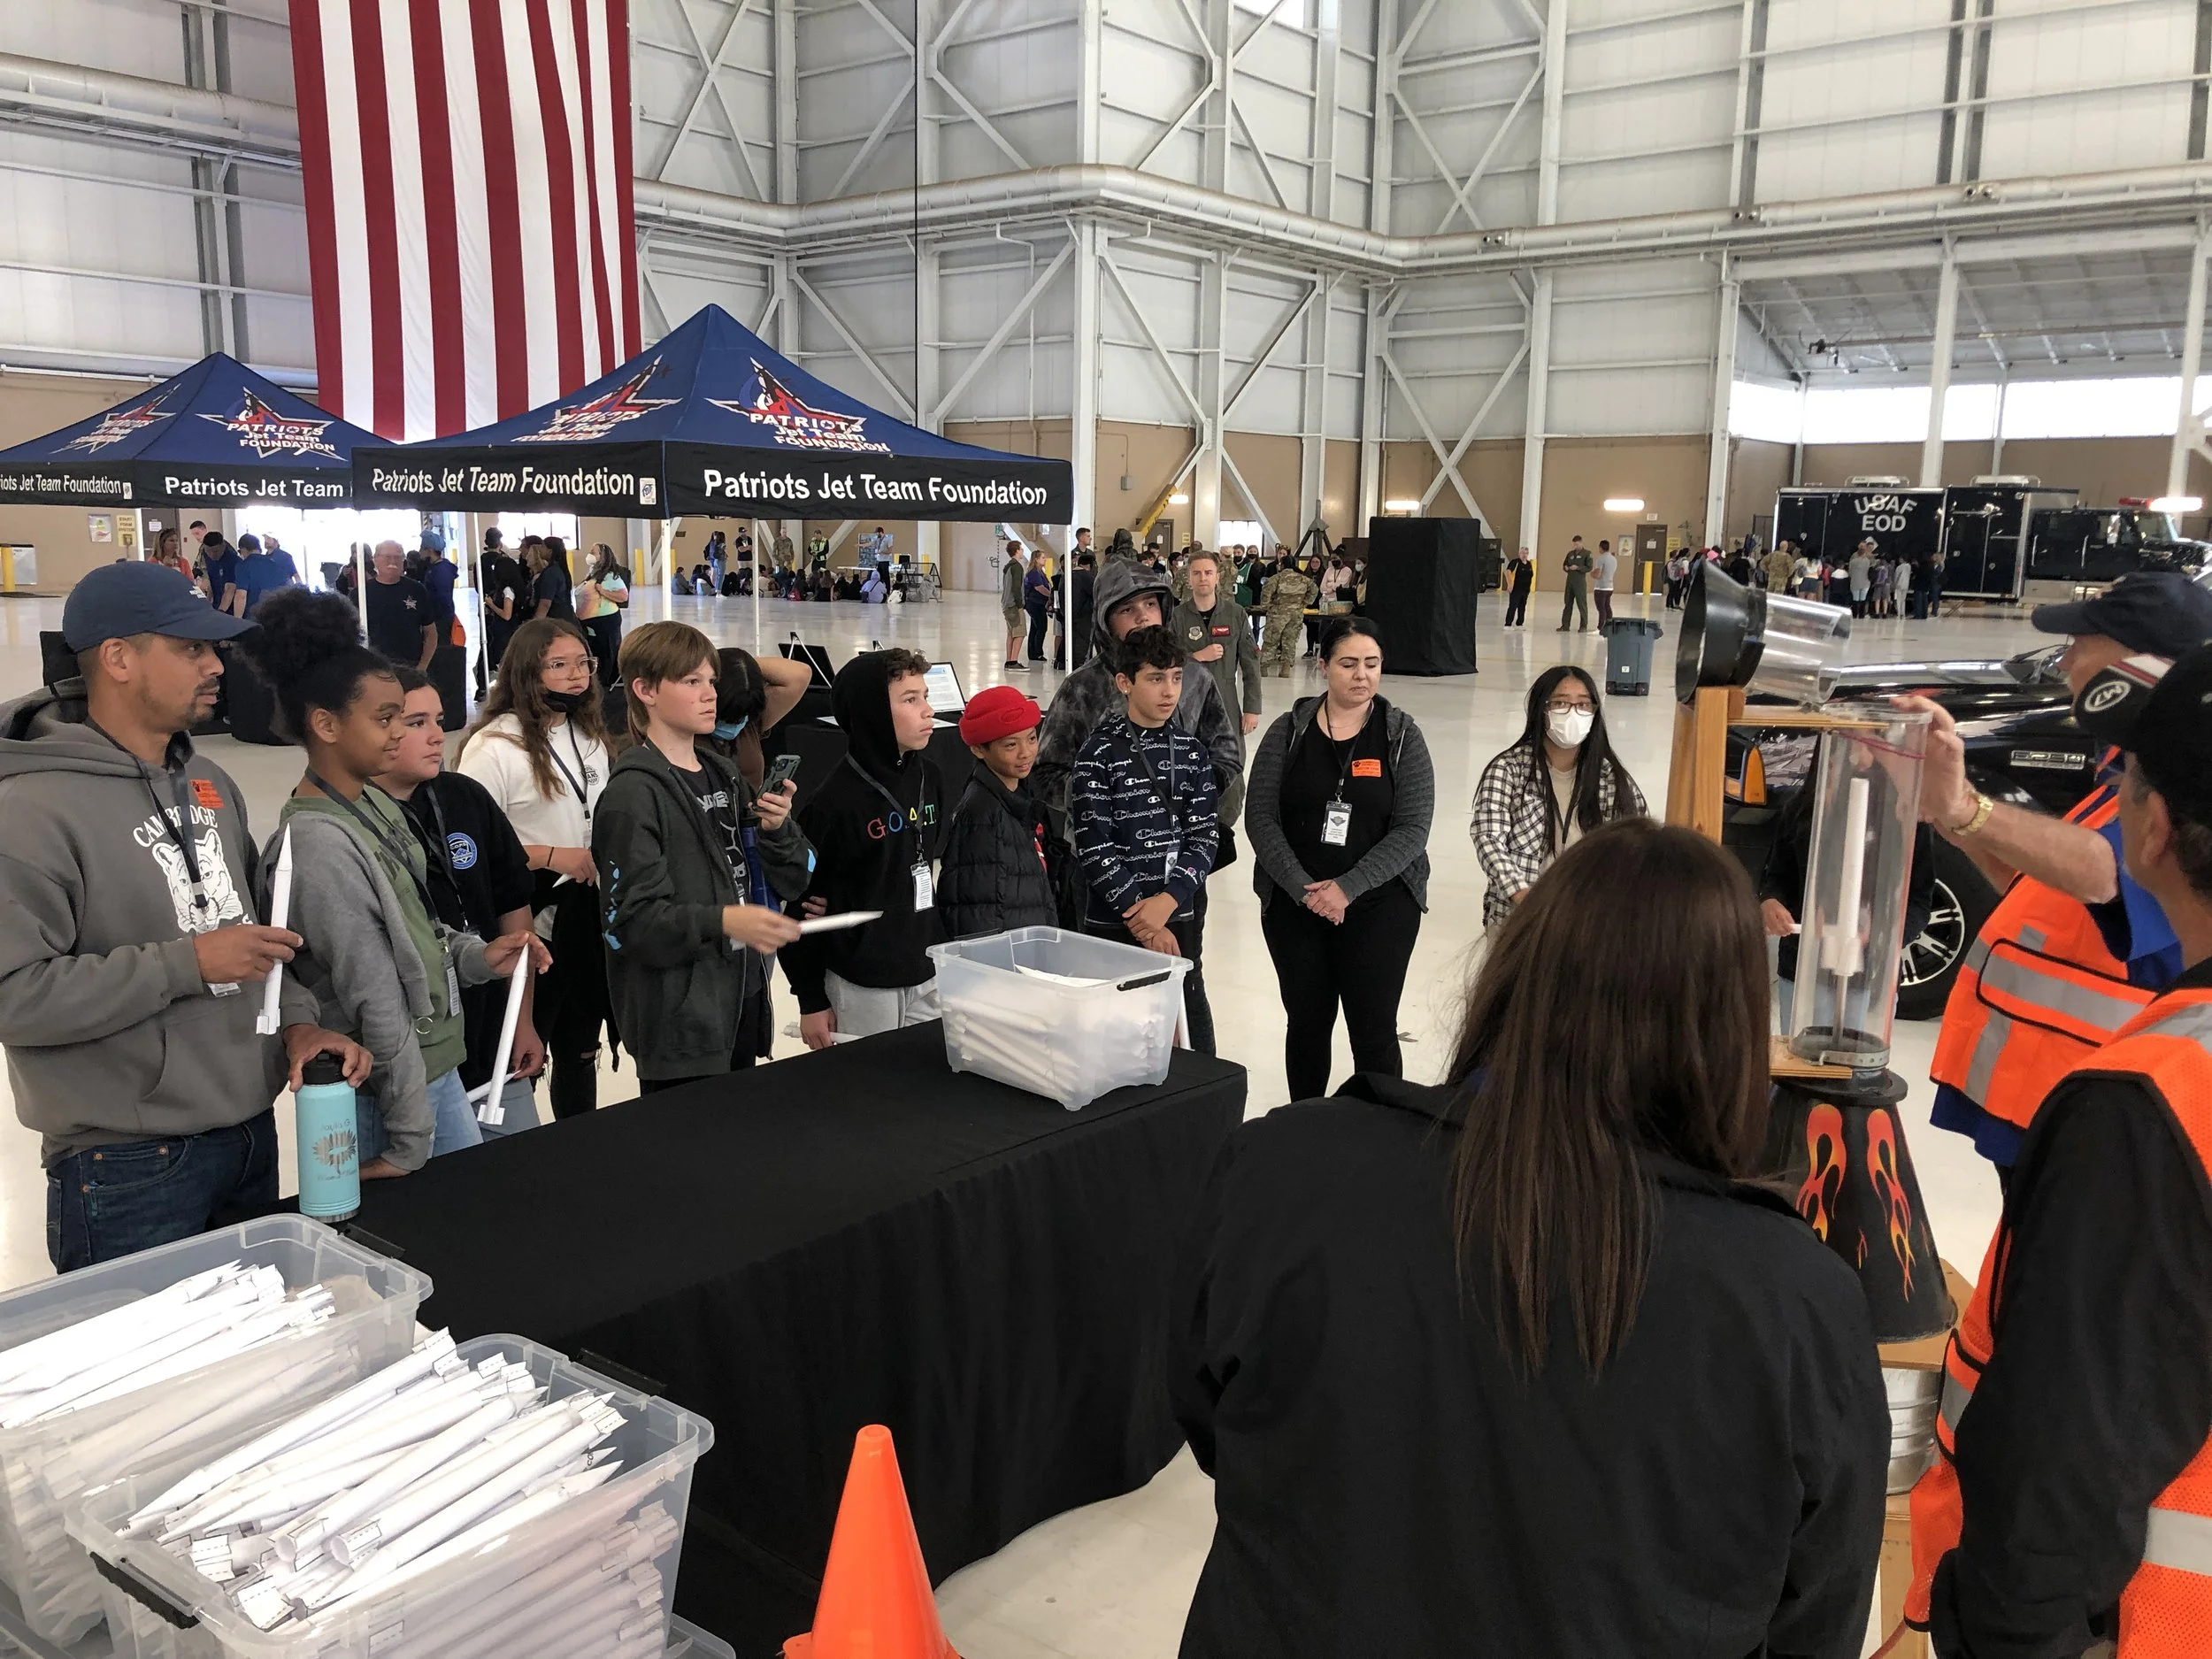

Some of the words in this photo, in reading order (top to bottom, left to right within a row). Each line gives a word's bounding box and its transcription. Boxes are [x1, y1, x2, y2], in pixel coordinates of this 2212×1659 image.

[227, 423, 325, 436] PATRIOTS
[749, 412, 864, 433] PATRIOTS
[244, 432, 270, 441] Jet
[278, 431, 320, 442] Team
[774, 425, 807, 437] Jet
[813, 428, 866, 442] Team
[239, 439, 335, 451] FOUNDATION
[773, 435, 891, 452] FOUNDATION
[19, 473, 35, 492] Jet
[35, 473, 62, 492] Team
[63, 474, 122, 495] Foundation
[165, 476, 250, 496] Patriots
[255, 479, 287, 497] Jet
[291, 480, 344, 497] Team
[372, 467, 434, 494] Patriots
[438, 467, 465, 493] Jet
[469, 465, 517, 494] Team
[519, 466, 635, 495] Foundation
[703, 469, 811, 500] Patriots
[817, 472, 856, 500] Jet
[860, 473, 924, 501] Team
[928, 476, 1048, 505] Foundation
[1854, 494, 1918, 515] USAF
[1861, 514, 1907, 532] EOD
